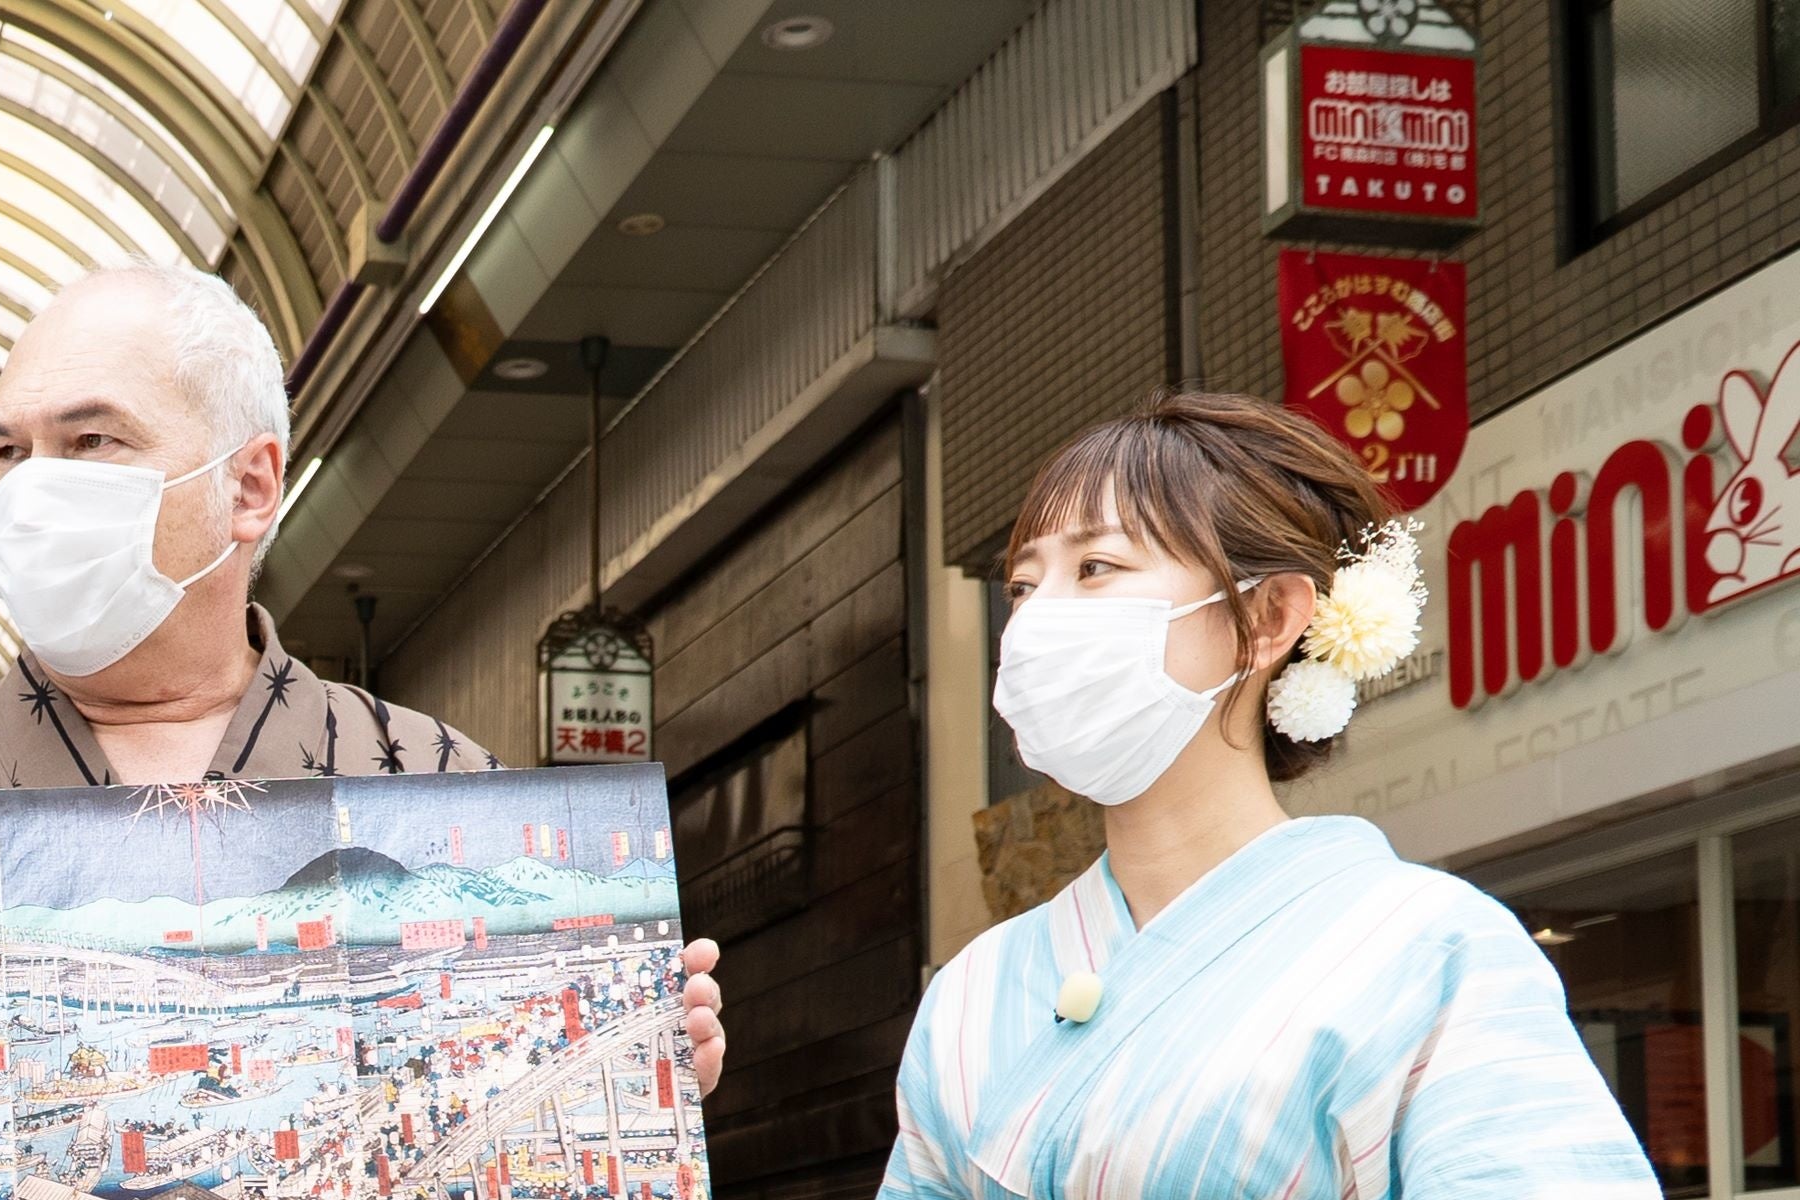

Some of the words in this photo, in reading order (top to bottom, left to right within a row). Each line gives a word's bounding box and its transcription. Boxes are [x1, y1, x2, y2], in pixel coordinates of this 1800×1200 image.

[1324, 70, 1452, 102] お部屋探しは
[1315, 174, 1467, 205] TAKUTO
[572, 680, 631, 702] ようこそ
[555, 726, 647, 756] 天神橋2
